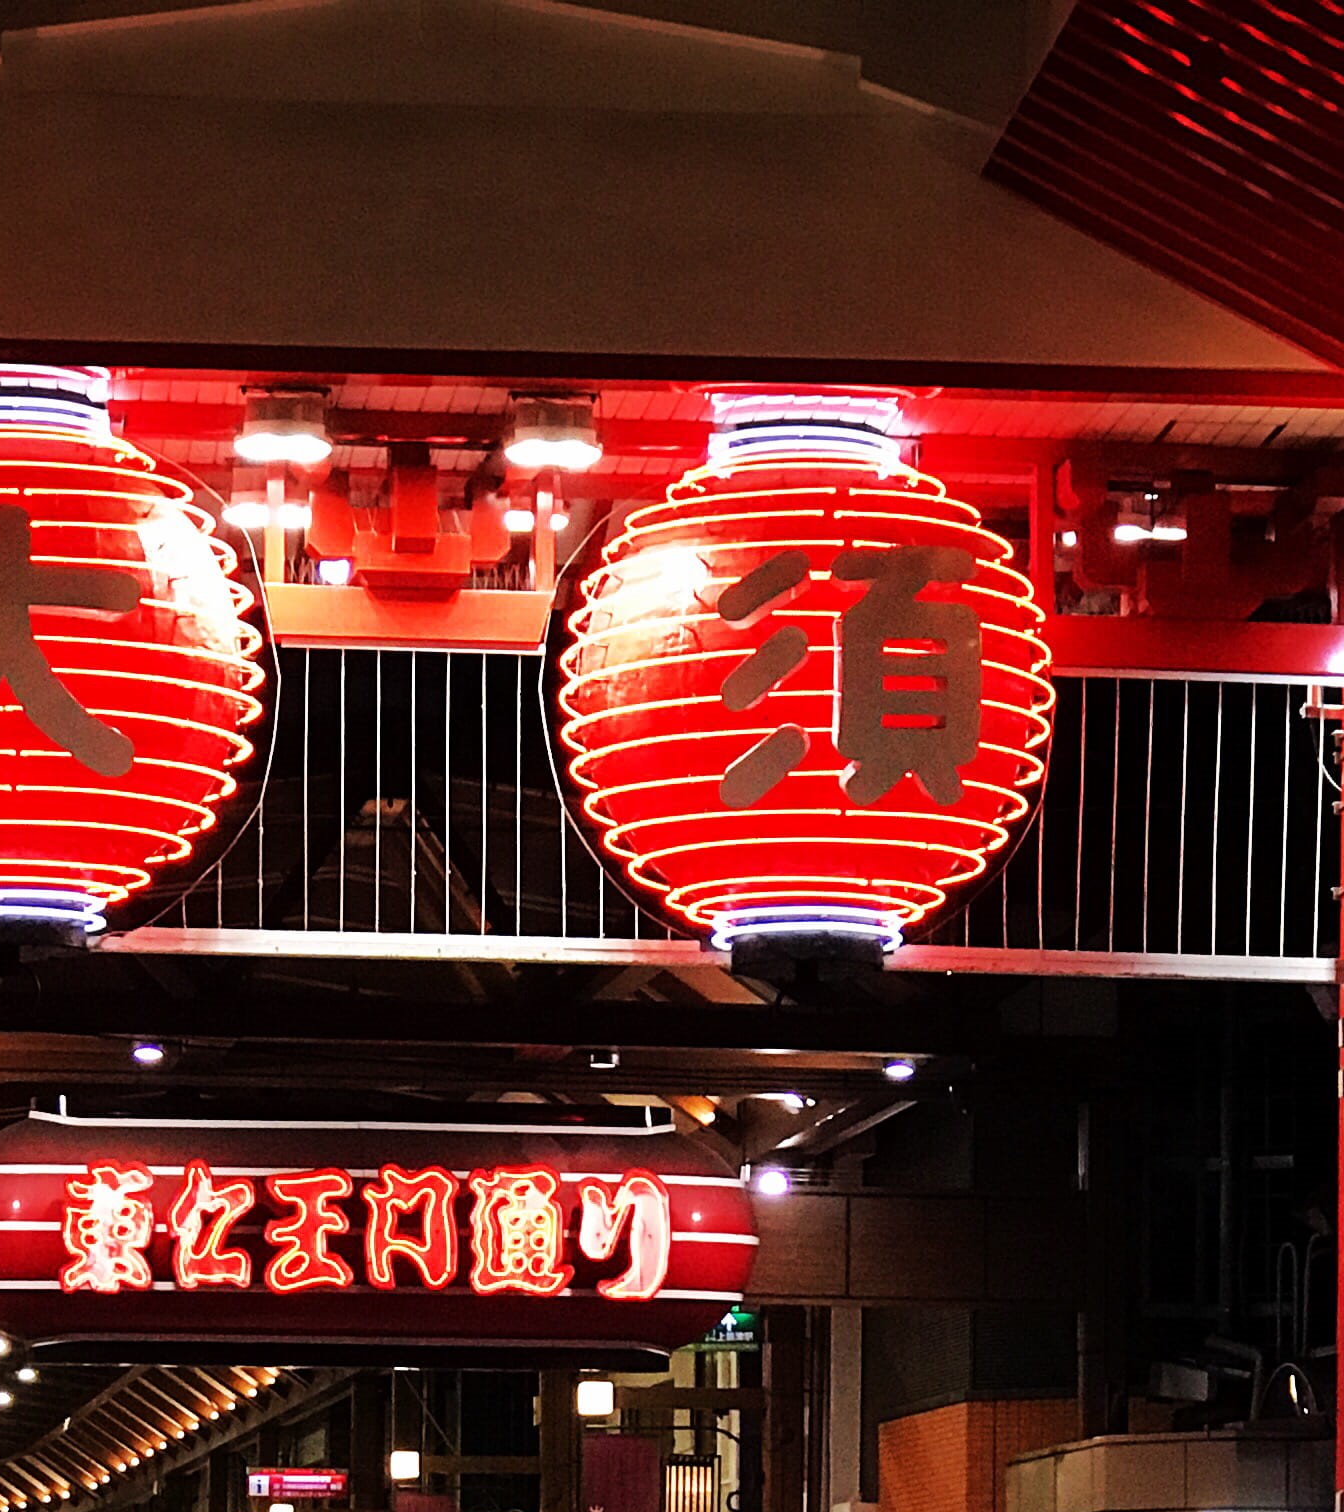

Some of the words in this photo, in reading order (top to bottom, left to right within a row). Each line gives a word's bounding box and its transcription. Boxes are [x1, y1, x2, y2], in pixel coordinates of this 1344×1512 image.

[717, 546, 982, 808] 須
[59, 1159, 670, 1300] 東仁王門通り
